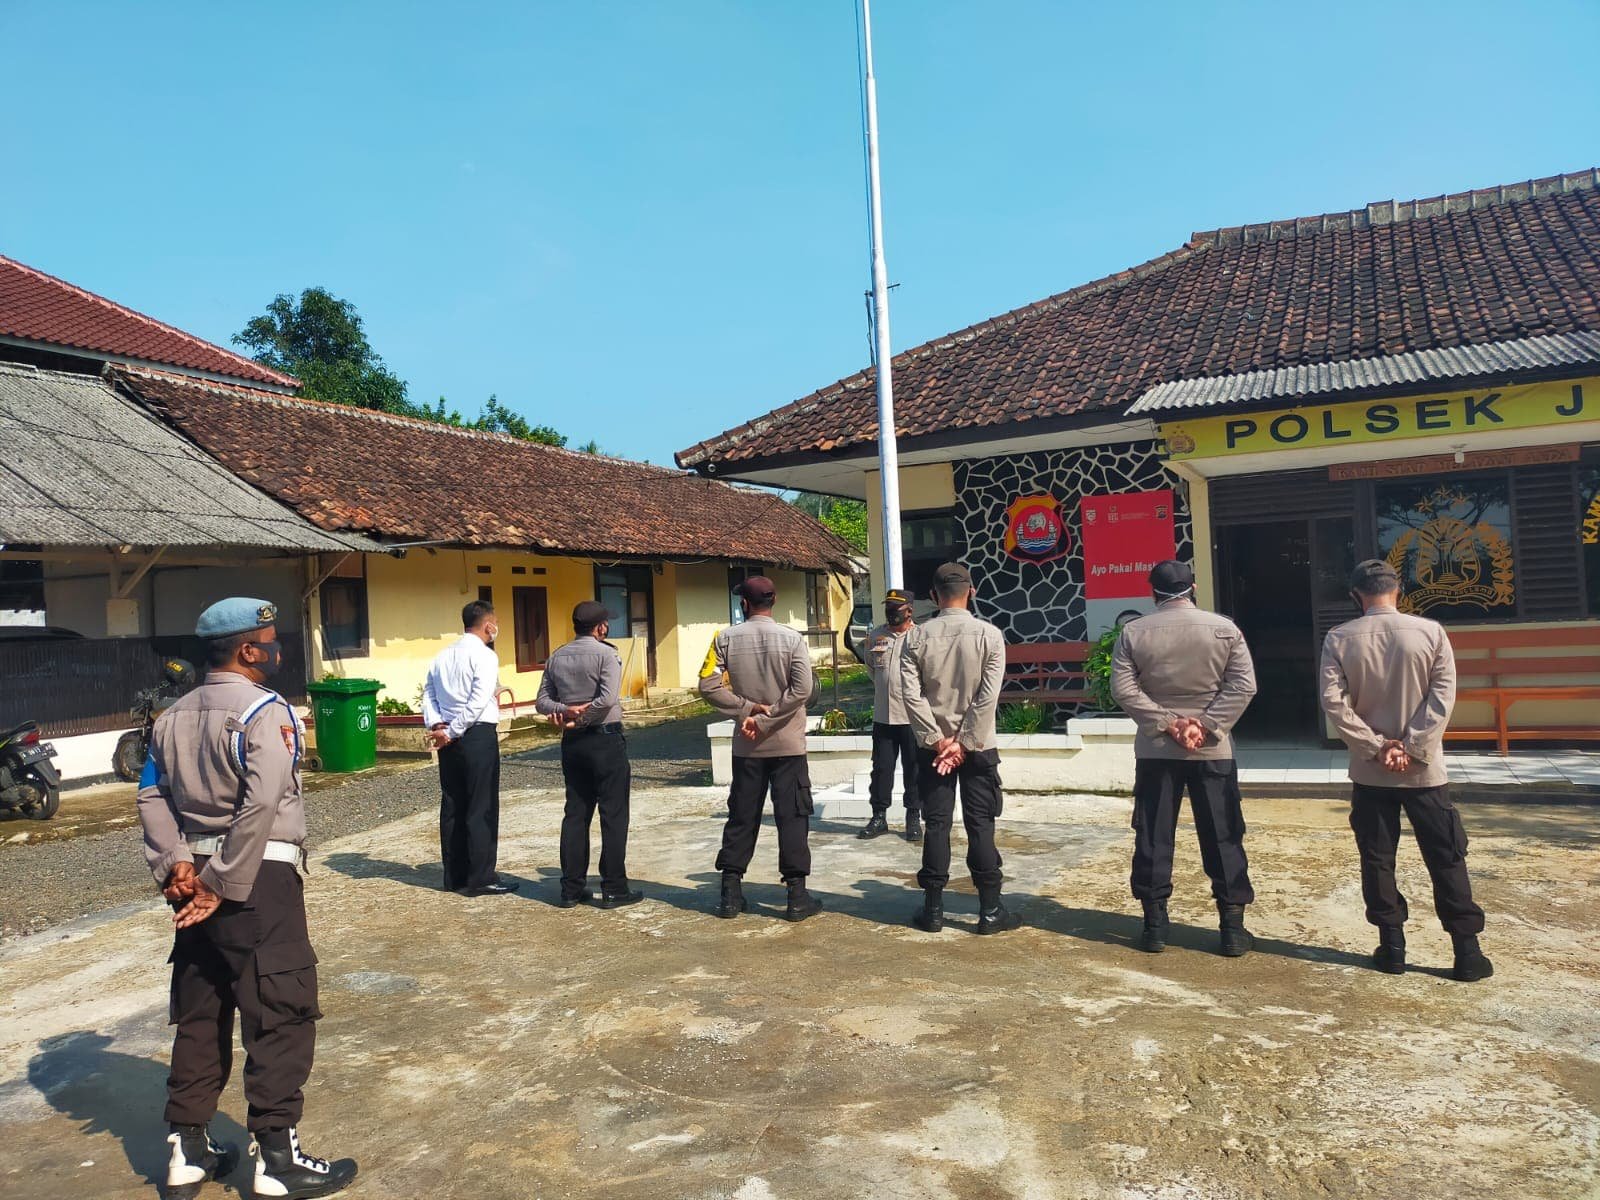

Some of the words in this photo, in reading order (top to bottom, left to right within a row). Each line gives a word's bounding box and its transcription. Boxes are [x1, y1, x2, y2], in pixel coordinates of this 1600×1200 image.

[1225, 392, 1504, 449] POLSEK
[1091, 565, 1107, 577] Ayo
[1108, 563, 1133, 574] Pakai
